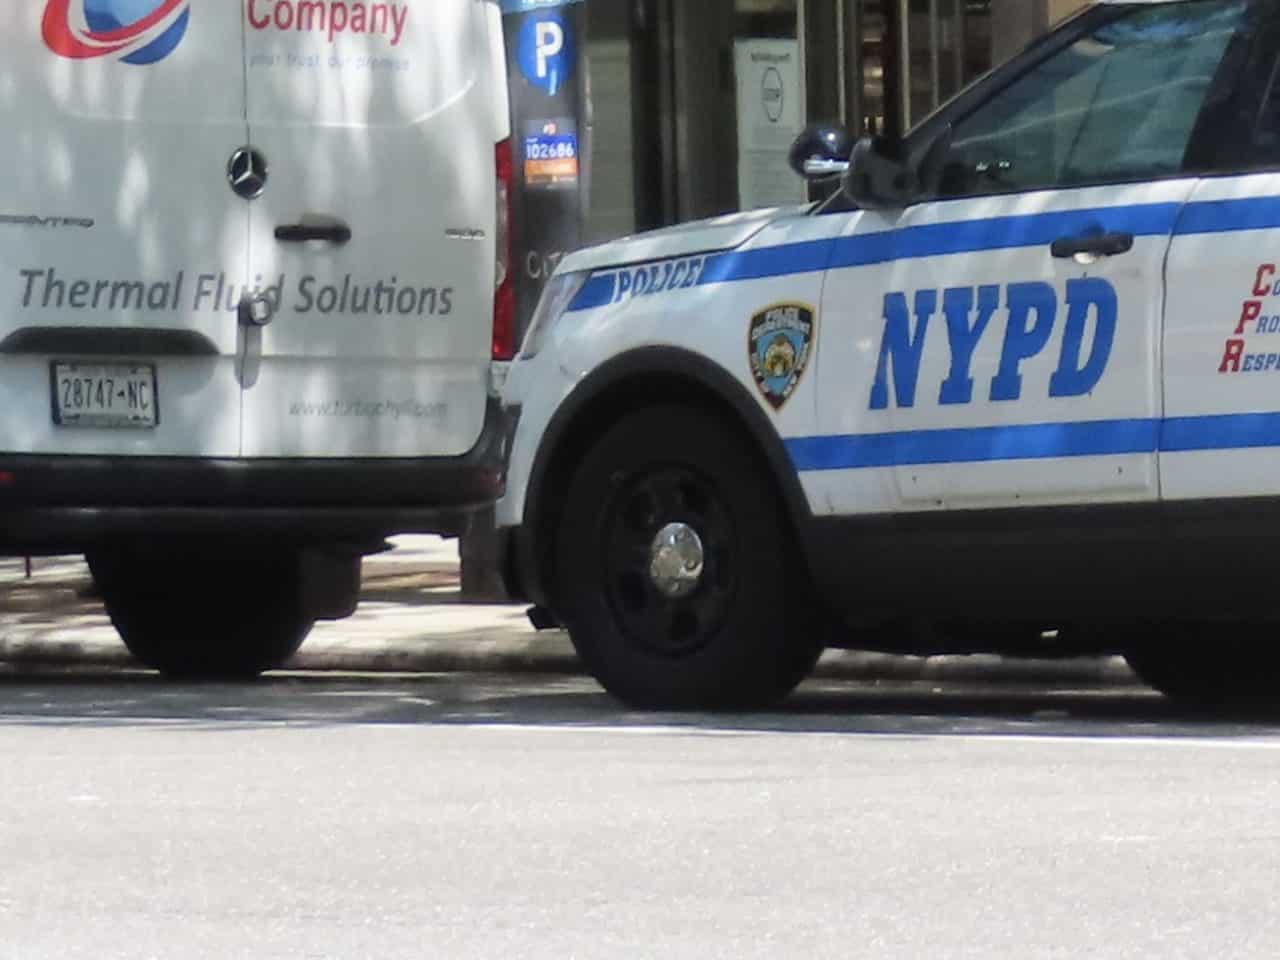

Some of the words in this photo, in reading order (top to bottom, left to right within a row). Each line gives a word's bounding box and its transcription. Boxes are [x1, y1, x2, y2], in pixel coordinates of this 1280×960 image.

[19, 269, 183, 311] Thermal
[293, 276, 453, 318] Solutions
[614, 257, 702, 303] POLICE
[868, 277, 1118, 410] NYPD
